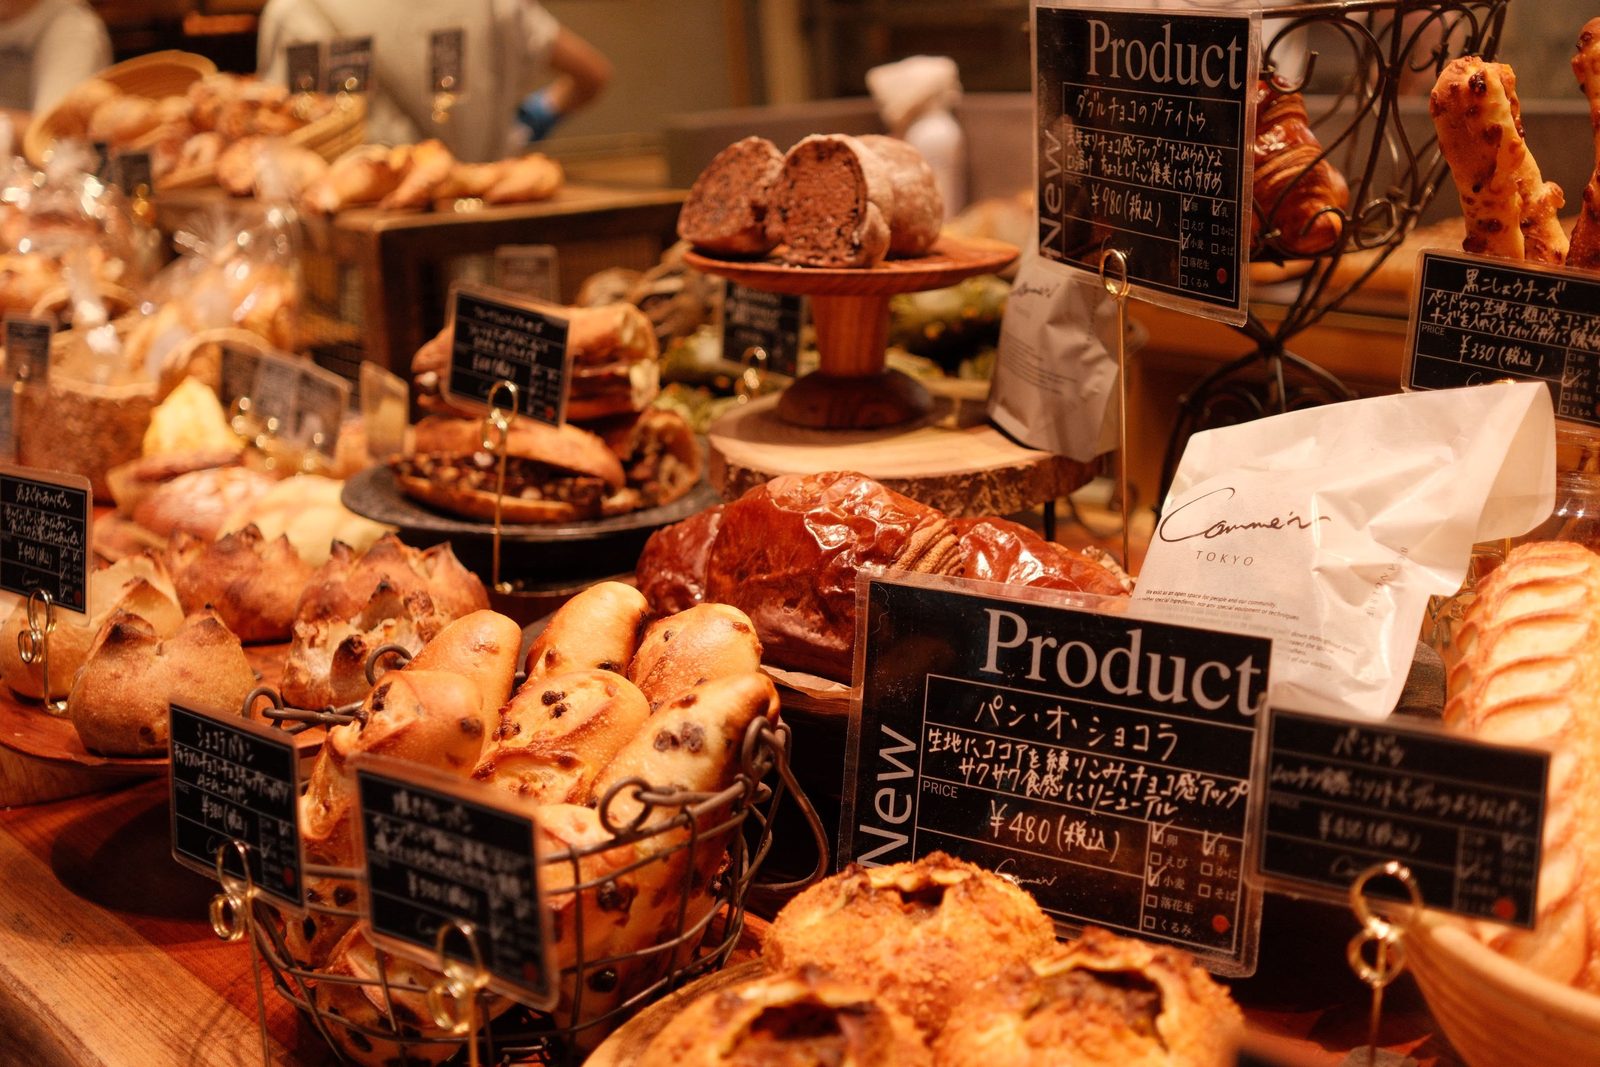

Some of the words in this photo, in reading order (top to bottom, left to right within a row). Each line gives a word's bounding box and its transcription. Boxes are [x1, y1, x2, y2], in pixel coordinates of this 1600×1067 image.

[1086, 19, 1242, 90] Product
[1039, 129, 1062, 258] New
[1421, 324, 1446, 336] PRICE
[1196, 550, 1254, 567] TOKYO
[979, 607, 1266, 716] Product
[923, 780, 958, 799] PRICE
[1165, 855, 1188, 869] えび
[1164, 876, 1185, 890] 小麦
[1161, 896, 1194, 914] 落花生
[1161, 917, 1192, 936] くるみ
